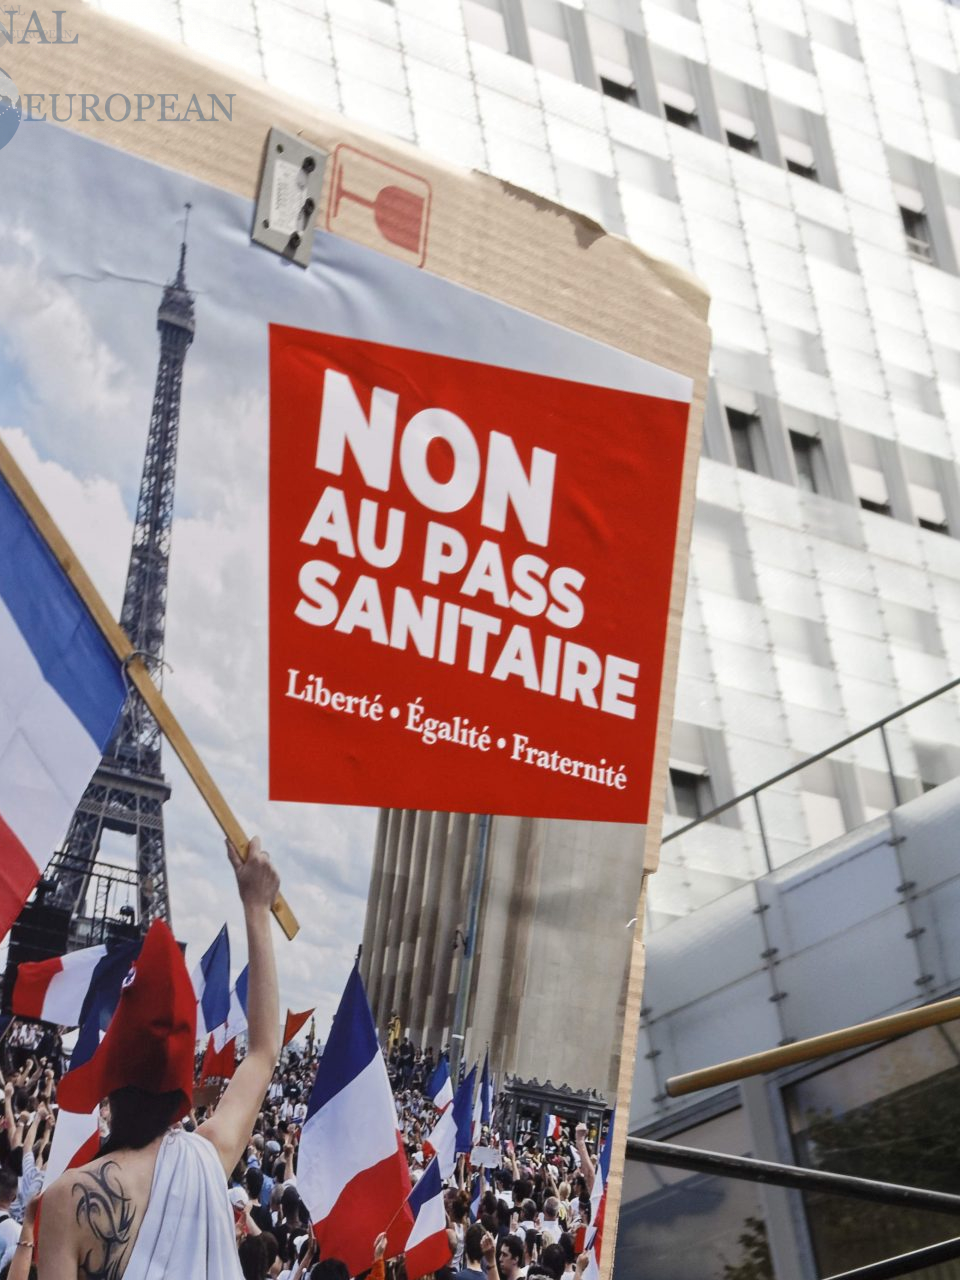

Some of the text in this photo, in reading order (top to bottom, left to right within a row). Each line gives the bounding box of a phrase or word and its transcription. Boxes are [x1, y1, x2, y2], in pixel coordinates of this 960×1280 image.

[315, 368, 557, 547] NON
[300, 486, 586, 629] AU PASS
[294, 560, 640, 720] SANITAIRE
[285, 669, 628, 791] Liberté Égalité Fraternité
